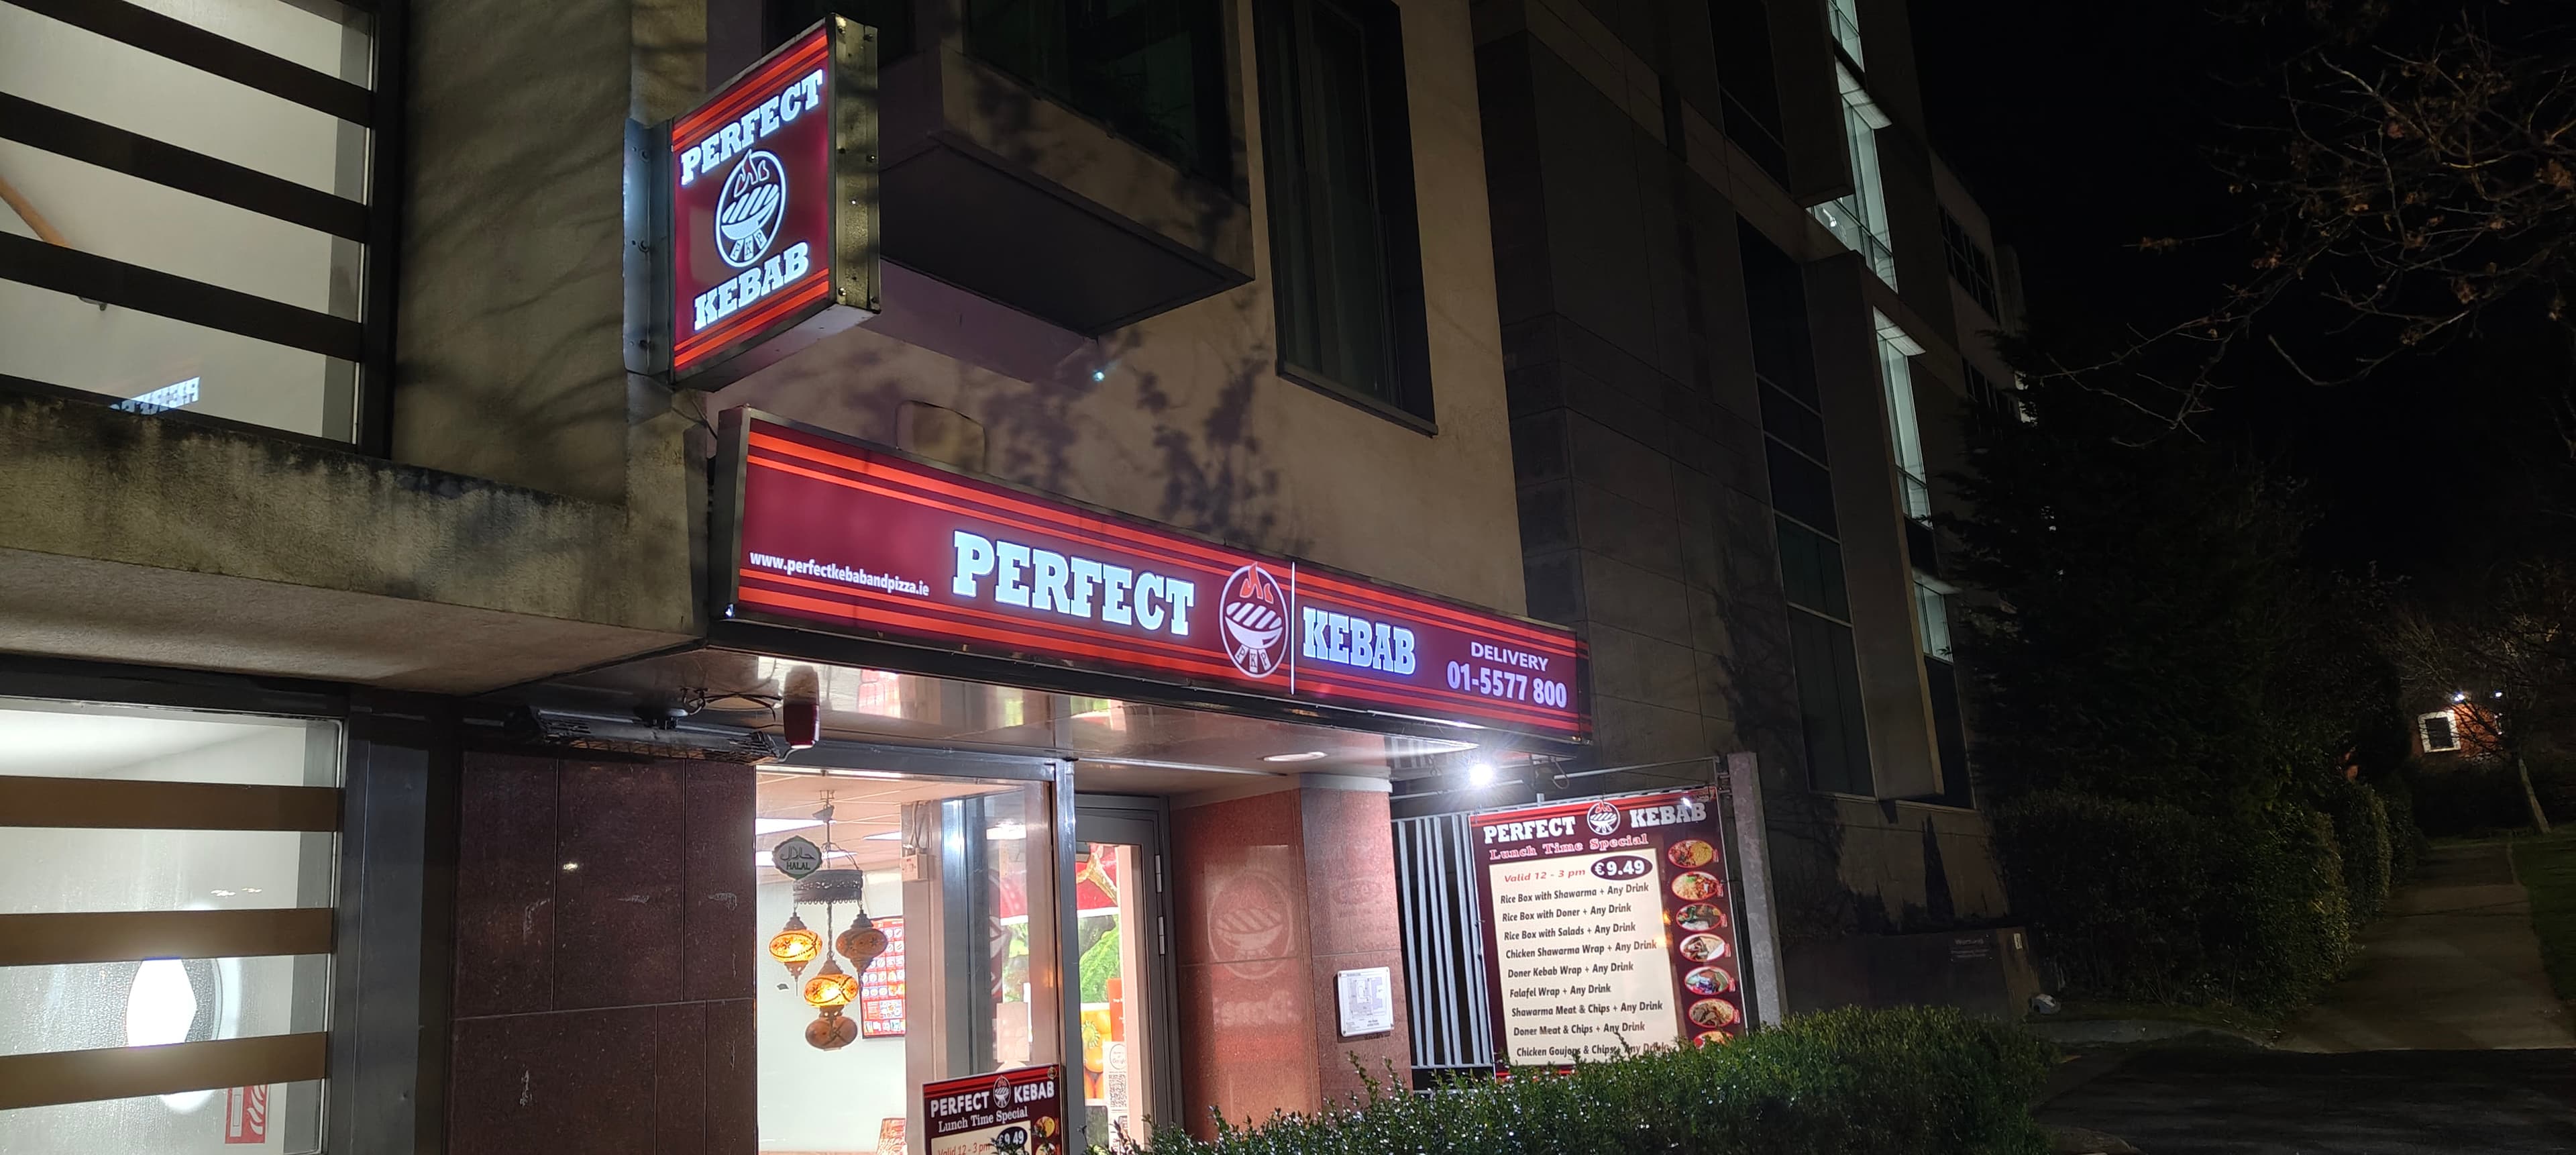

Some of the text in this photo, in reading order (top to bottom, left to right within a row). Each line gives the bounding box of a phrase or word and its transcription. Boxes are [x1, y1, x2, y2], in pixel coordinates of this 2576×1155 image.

[680, 68, 823, 186] PERFECT
[693, 241, 810, 332] KEBAB
[749, 551, 930, 597] www.perfectkebabandpizza.ie
[953, 530, 1417, 676] PERFECT KEBAB
[1470, 641, 1550, 672] DELIVERY
[1446, 660, 1568, 709] 01-5577 800
[1483, 802, 1707, 844] PERFECT KEBAB
[1489, 833, 1650, 860] Lunch Time Special
[786, 861, 811, 870] HALAL
[1594, 859, 1646, 876] €9.49
[1504, 872, 1532, 883] Valid
[1534, 871, 1547, 880] 12
[1558, 870, 1564, 878] 3
[1567, 869, 1586, 878] pm
[1500, 894, 1516, 904] Rice
[1518, 893, 1533, 903] Box
[1534, 891, 1552, 901] with
[1554, 889, 1597, 899] Shawarma
[1607, 885, 1623, 897] Any
[1625, 882, 1649, 893] Drink
[1502, 913, 1518, 922] Rice
[1519, 911, 1535, 921] Box
[1536, 909, 1554, 919] with
[1556, 908, 1580, 918] Doner
[1590, 905, 1607, 917] Any
[1608, 902, 1631, 913] Drink
[1504, 931, 1520, 941] Rice
[1521, 930, 1537, 940] Box
[1538, 927, 1556, 938] with
[1558, 925, 1585, 937] Salads
[1594, 924, 1611, 936] Any
[1613, 921, 1636, 933] Drink
[1505, 948, 1536, 959] Chicken
[1537, 947, 1580, 957] Shawarma
[1582, 944, 1605, 955] Wrap
[1615, 942, 1631, 954] Any
[1633, 939, 1657, 950] Drink
[1507, 968, 1532, 978] Doner
[1533, 966, 1558, 977] Kebab
[1560, 965, 1582, 976] Wrap
[1592, 963, 1609, 975] Any
[1610, 960, 1634, 972] Drink
[1509, 987, 1537, 999] Falafel
[1538, 987, 1560, 998] Wrap
[1569, 985, 1587, 997] Any
[1588, 983, 1611, 994] Drink
[1511, 1007, 1554, 1017] Shawarma
[1555, 1005, 1577, 1015] Meat
[1578, 1004, 1586, 1014] &
[1588, 1003, 1611, 1015] Chips
[1620, 1002, 1638, 1014] Any
[1639, 1000, 1663, 1011] Drink
[1513, 1027, 1538, 1036] Doner
[1539, 1025, 1562, 1035] Meat
[1562, 1025, 1569, 1034] &
[1571, 1023, 1593, 1036] Chips
[1603, 1023, 1620, 1034] Any
[1621, 1021, 1646, 1032] Drink
[1516, 1046, 1547, 1057] Chicken
[1583, 1045, 1589, 1054] &
[930, 1081, 1055, 1118] PERFECT KEBAB
[938, 1106, 1028, 1133] Lunch Time Special
[957, 1144, 967, 1155] 12
[973, 1142, 977, 1153] 3
